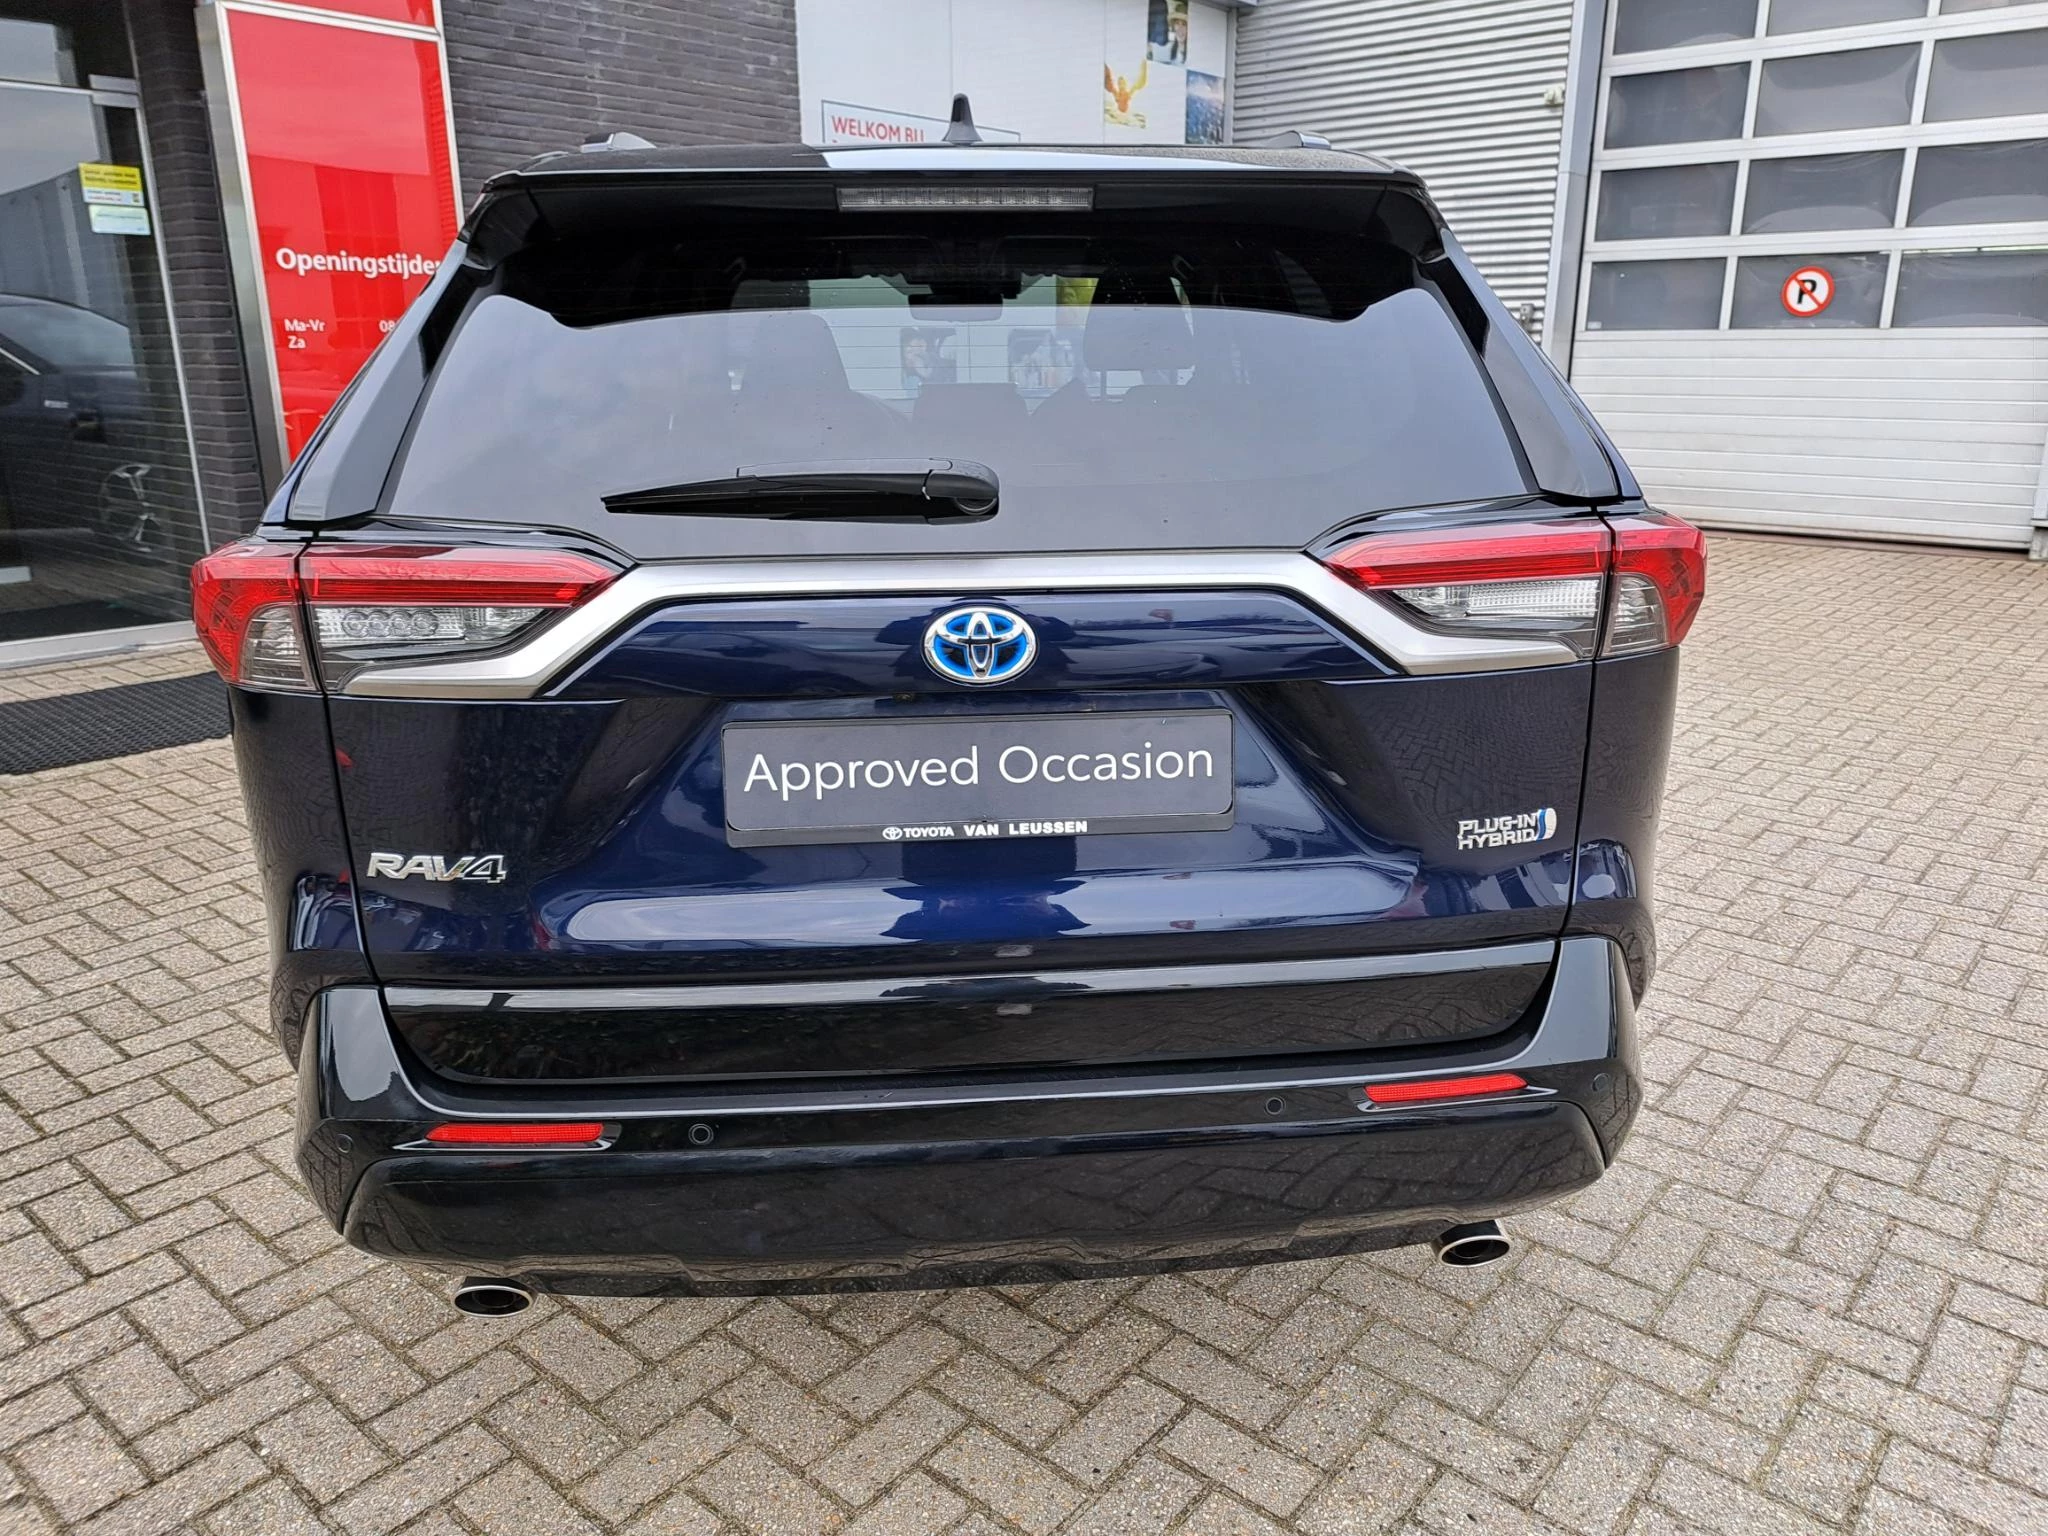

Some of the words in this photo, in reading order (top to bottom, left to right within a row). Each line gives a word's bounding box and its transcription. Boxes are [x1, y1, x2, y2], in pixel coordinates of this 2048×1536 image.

[831, 115, 900, 142] WELKOM
[275, 248, 441, 279] Openingstijde
[284, 319, 326, 332] Ma-Vr
[288, 335, 307, 349] Za
[743, 745, 979, 801] Approved
[999, 741, 1213, 784] Occasion
[903, 826, 955, 838] TOYOTA
[963, 823, 999, 837] VAN
[1009, 820, 1088, 836] LEUSSEN
[1458, 812, 1538, 836] PLUG-IN
[1458, 828, 1538, 850] HYBRID
[366, 852, 507, 883] RAV4
